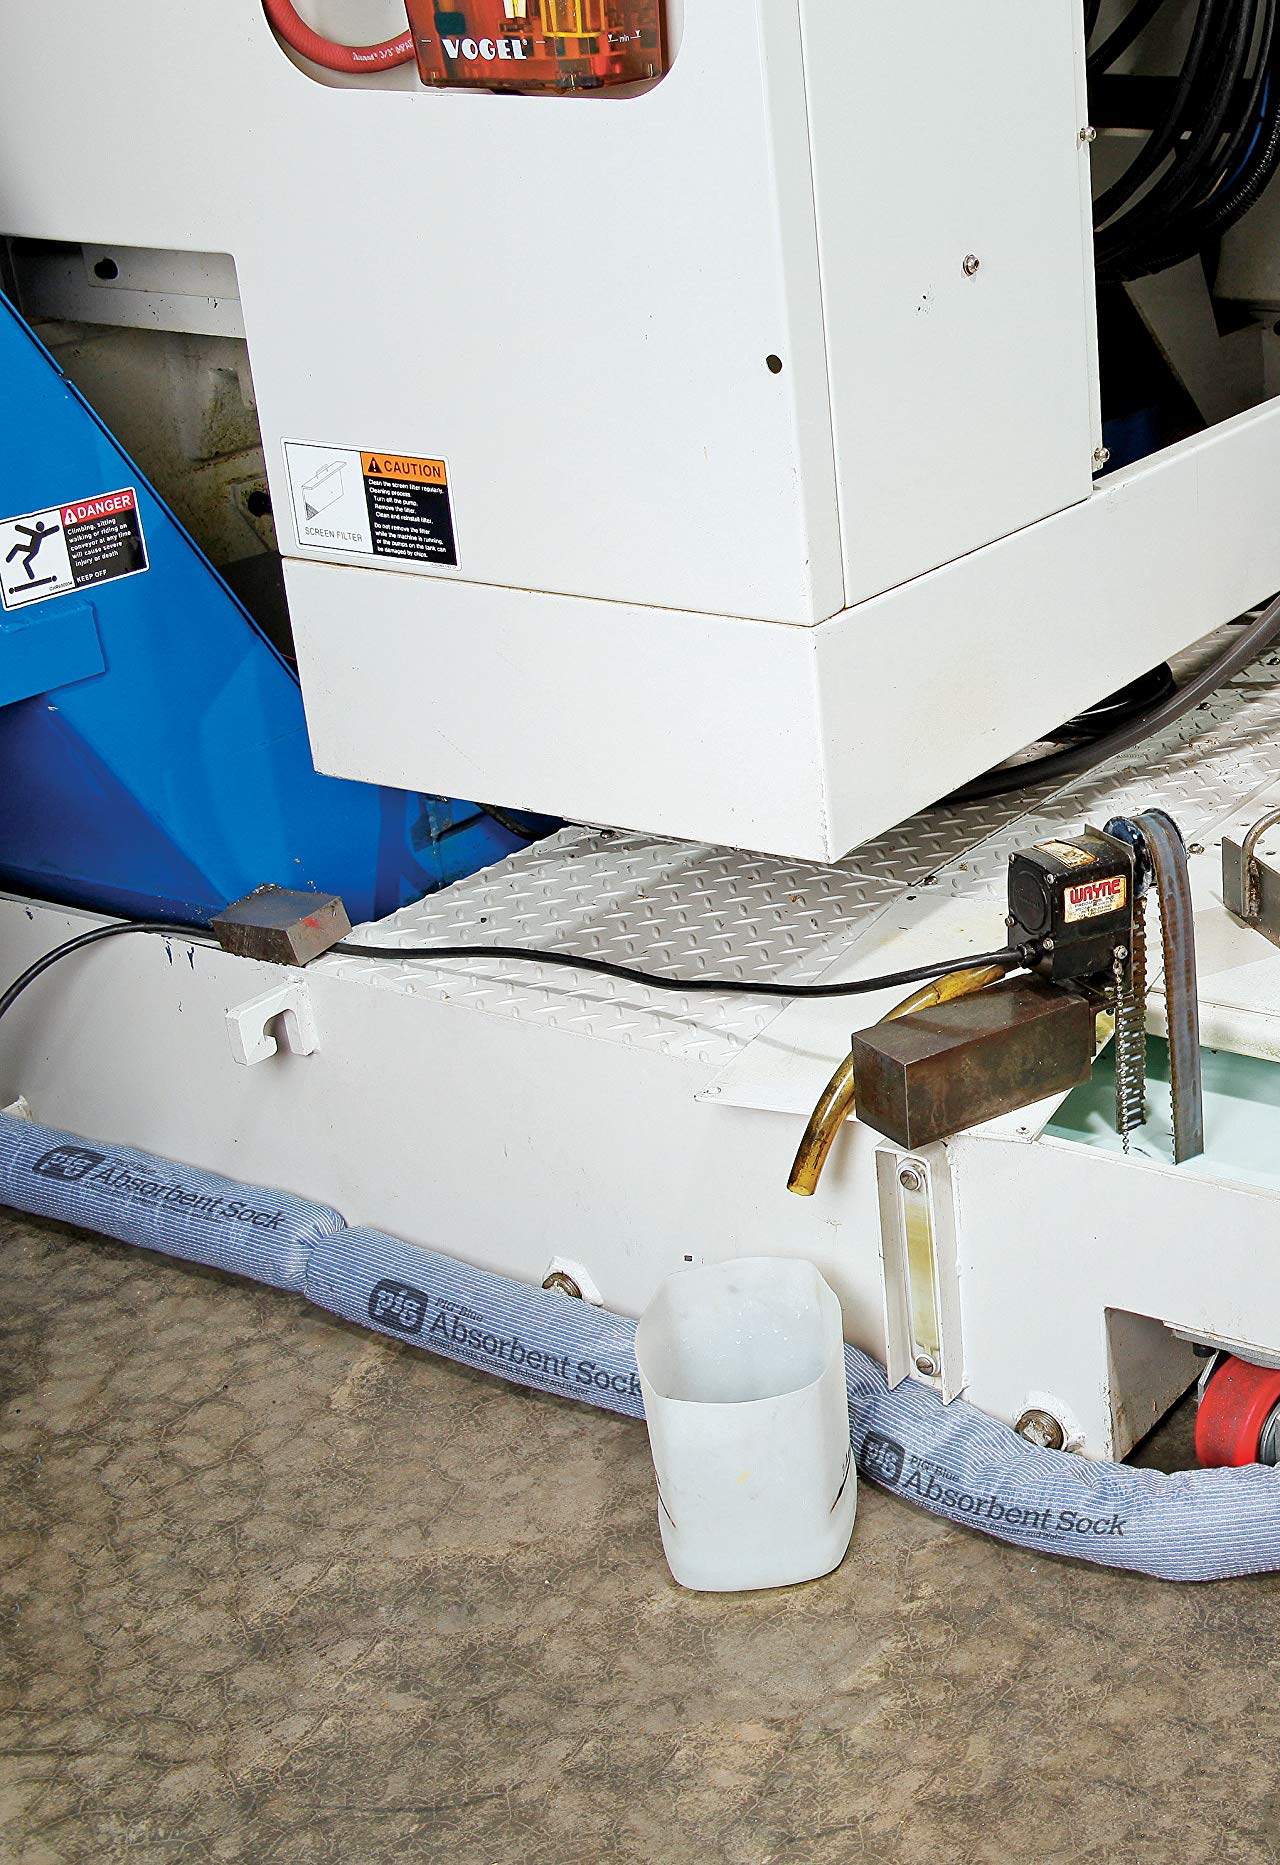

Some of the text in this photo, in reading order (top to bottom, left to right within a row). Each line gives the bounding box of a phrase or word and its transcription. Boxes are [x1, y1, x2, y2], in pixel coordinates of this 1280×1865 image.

[441, 38, 527, 60] VOGEL
[383, 460, 441, 478] CAUTION
[77, 495, 131, 519] DANGER
[69, 533, 92, 543] walking
[101, 526, 118, 535] riding
[304, 526, 363, 542] SCREEN FILTER
[71, 540, 98, 552] conveyor
[72, 541, 122, 559] will cause severe
[75, 557, 92, 567] injury
[102, 550, 118, 559] death
[77, 569, 107, 583] KEEP OFF
[1070, 879, 1120, 904] WAYNE
[90, 1166, 224, 1213] Absorbent
[220, 1199, 286, 1230] Sock
[458, 1305, 484, 1322] Blue
[430, 1311, 570, 1379] Absorbent
[936, 1465, 960, 1483] Blue
[902, 1470, 1126, 1537] Absorbent Sock
